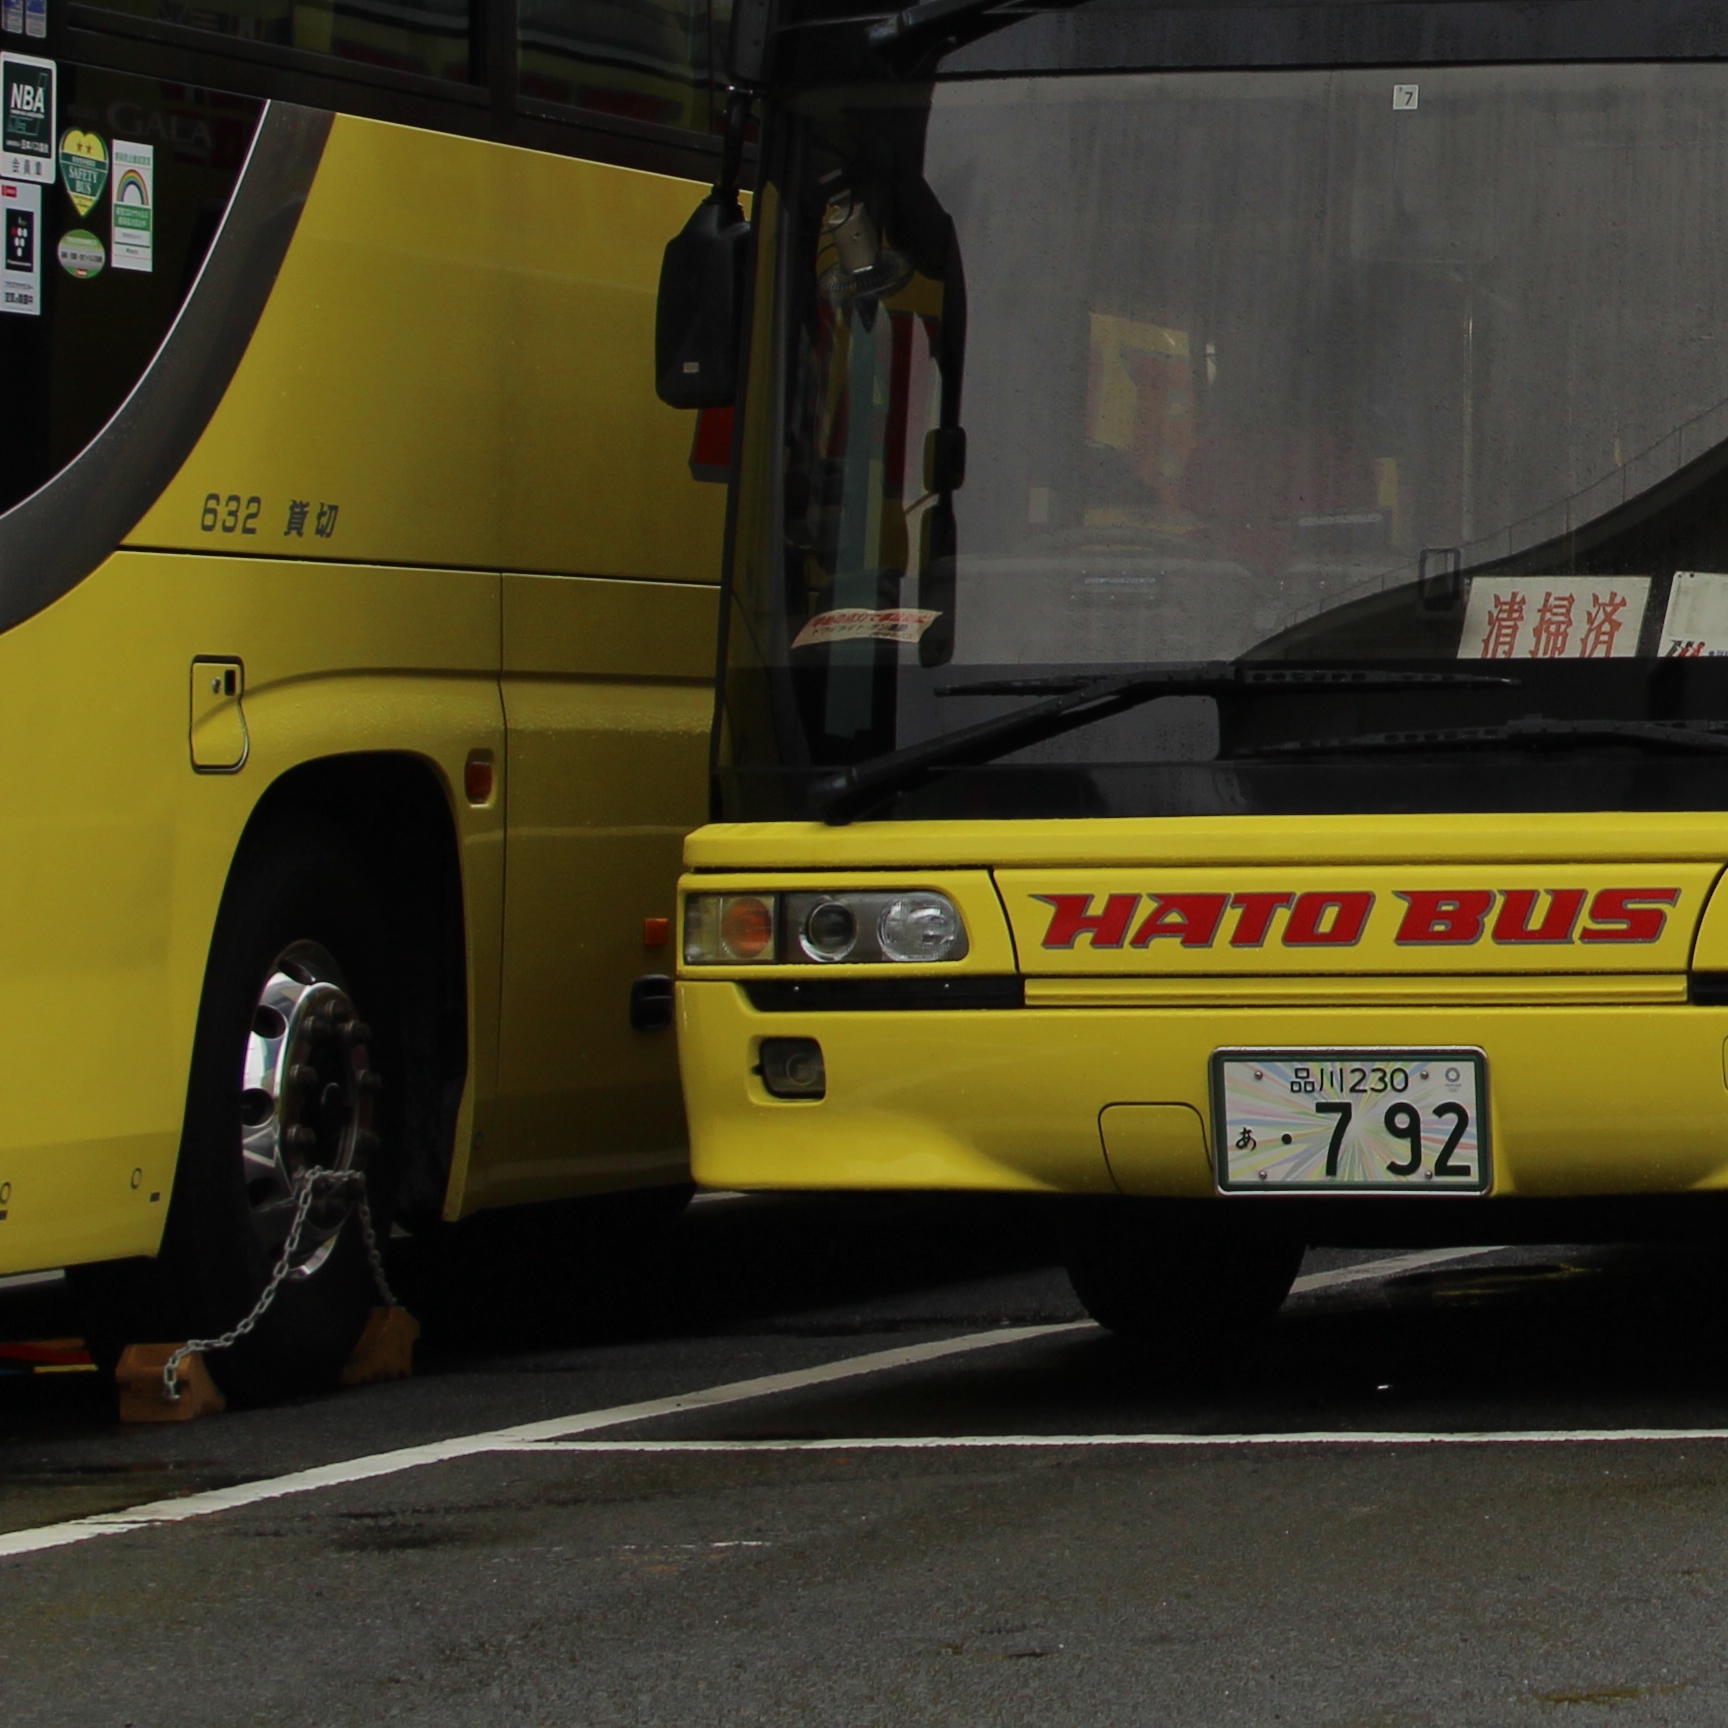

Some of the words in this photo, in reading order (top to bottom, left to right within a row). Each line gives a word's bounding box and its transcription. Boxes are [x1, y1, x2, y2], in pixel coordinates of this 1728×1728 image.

[10, 83, 45, 113] NBA
[68, 166, 98, 184] SAFETY
[75, 181, 93, 194] BUS
[201, 493, 261, 534] 632
[284, 499, 339, 538] 貸切
[1481, 590, 1628, 658] 清掃済
[1026, 889, 1376, 948] HATO
[1390, 887, 1682, 945] BUS
[1235, 1127, 1257, 1151] あ
